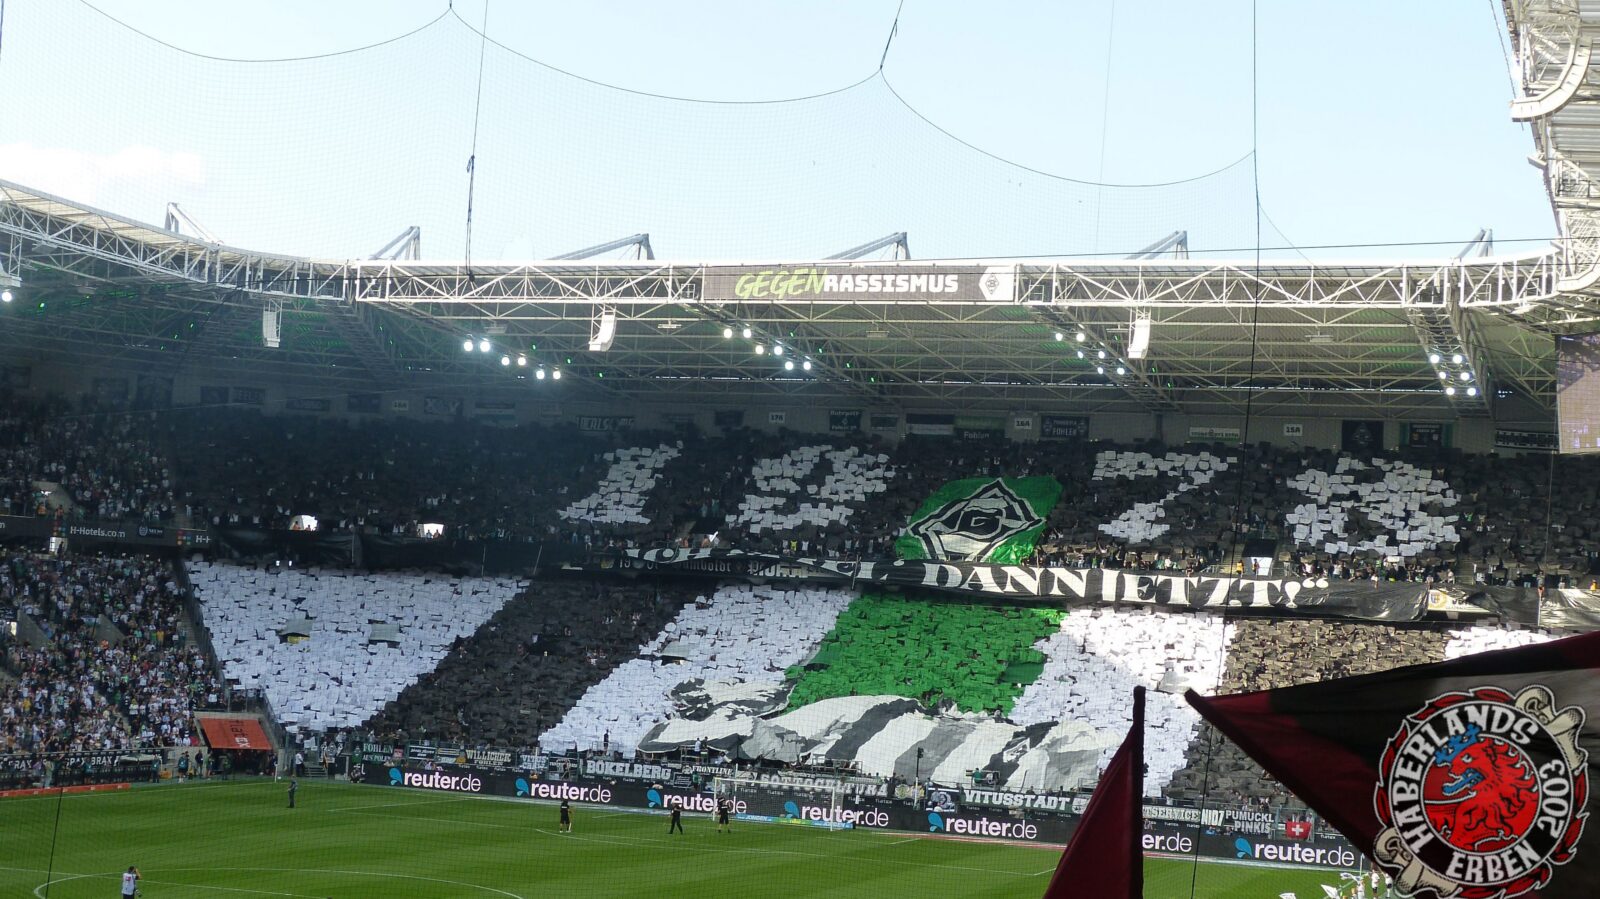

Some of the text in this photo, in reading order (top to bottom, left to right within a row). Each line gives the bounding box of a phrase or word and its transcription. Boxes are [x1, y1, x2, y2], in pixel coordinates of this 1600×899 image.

[734, 268, 959, 299] GEGEN RASSISMUS
[70, 526, 126, 539] H-Hotels.com
[586, 760, 672, 780] BÖKELBERG
[692, 765, 733, 776] FRONTLINE
[1392, 705, 1540, 853] HABERLANDS
[404, 771, 481, 793] reuter.de
[531, 782, 611, 804] reuter.de
[663, 793, 747, 813] reuterde
[963, 789, 1071, 811] VITUSSTADT
[1537, 760, 1570, 839] 2003
[801, 805, 889, 827] reuter.de
[1225, 809, 1275, 823] PUMUCKL
[946, 817, 1037, 839] reuter.de
[1254, 842, 1355, 867] reuter.de
[1446, 840, 1542, 882] ERBEN
